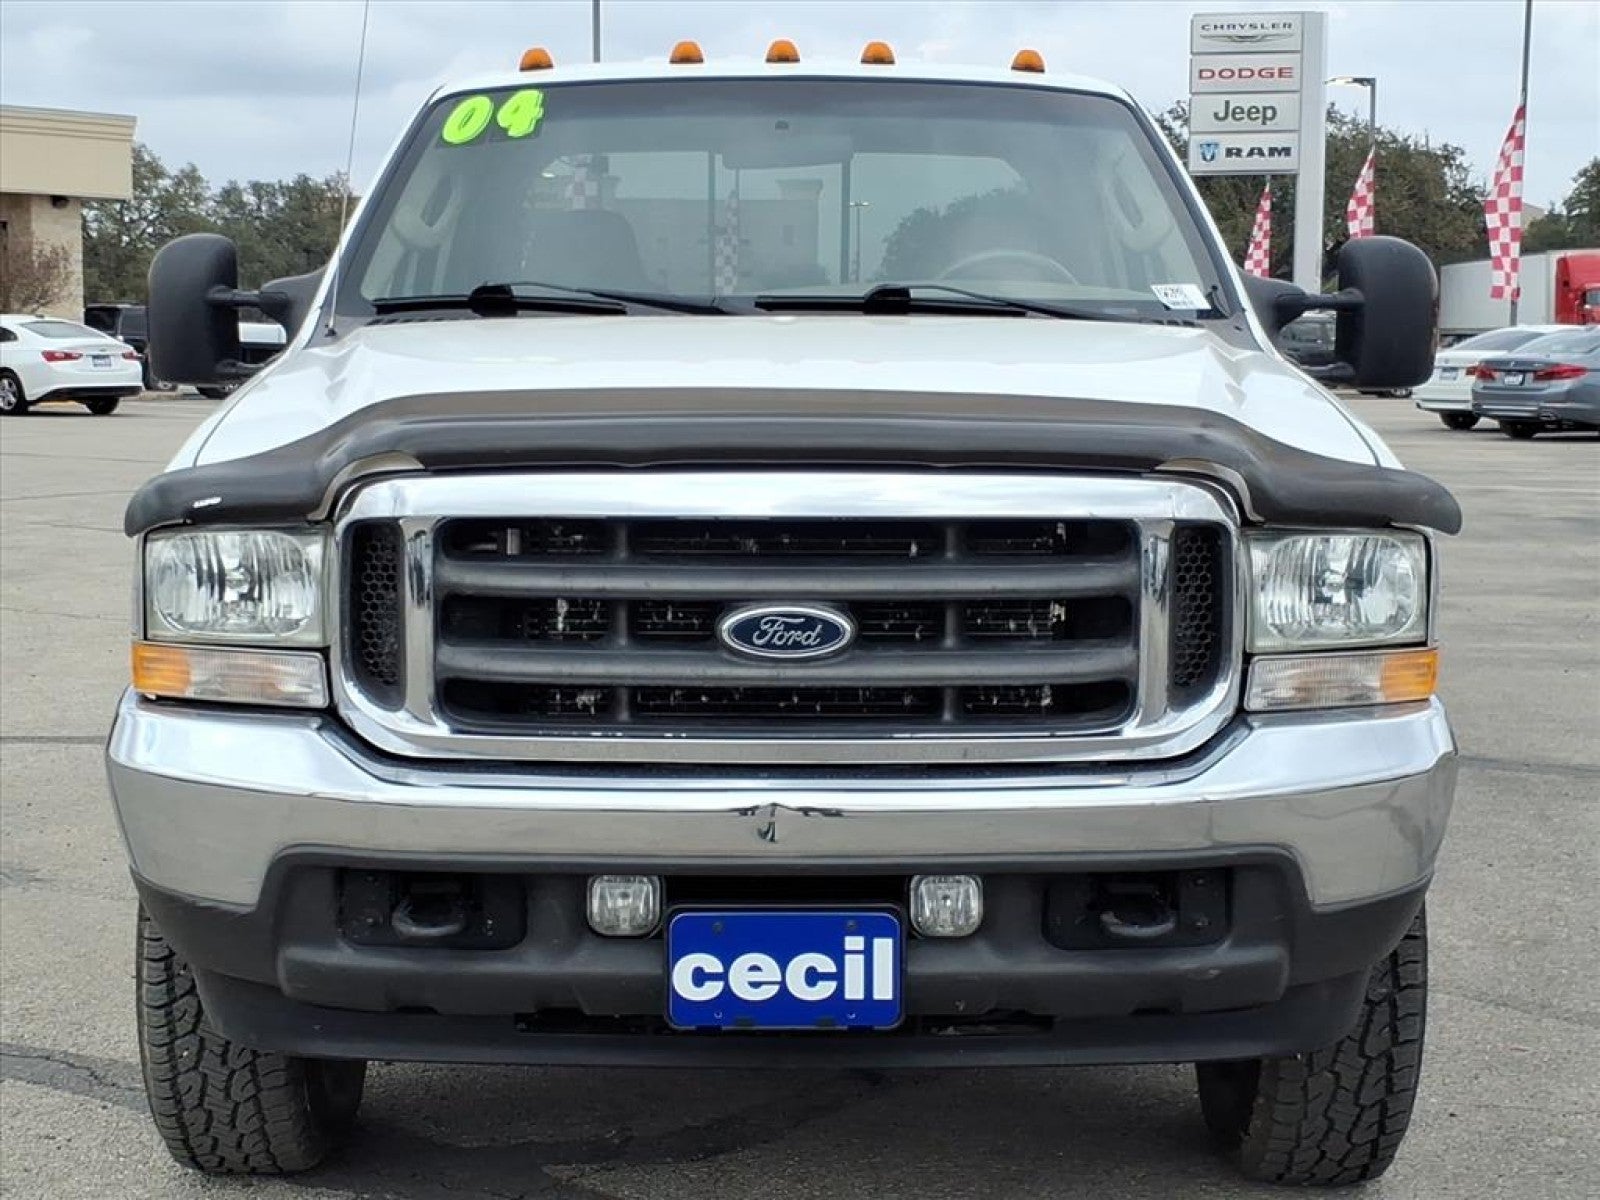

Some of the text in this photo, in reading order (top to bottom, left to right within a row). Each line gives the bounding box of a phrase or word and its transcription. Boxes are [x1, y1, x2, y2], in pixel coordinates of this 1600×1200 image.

[1200, 22, 1293, 31] CHRYSLER
[1199, 67, 1294, 80] DODGE
[442, 89, 544, 144] 04
[1213, 100, 1278, 125] Jeep
[1225, 147, 1292, 158] RAM
[752, 616, 822, 645] Ford
[672, 935, 893, 1001] cecil
